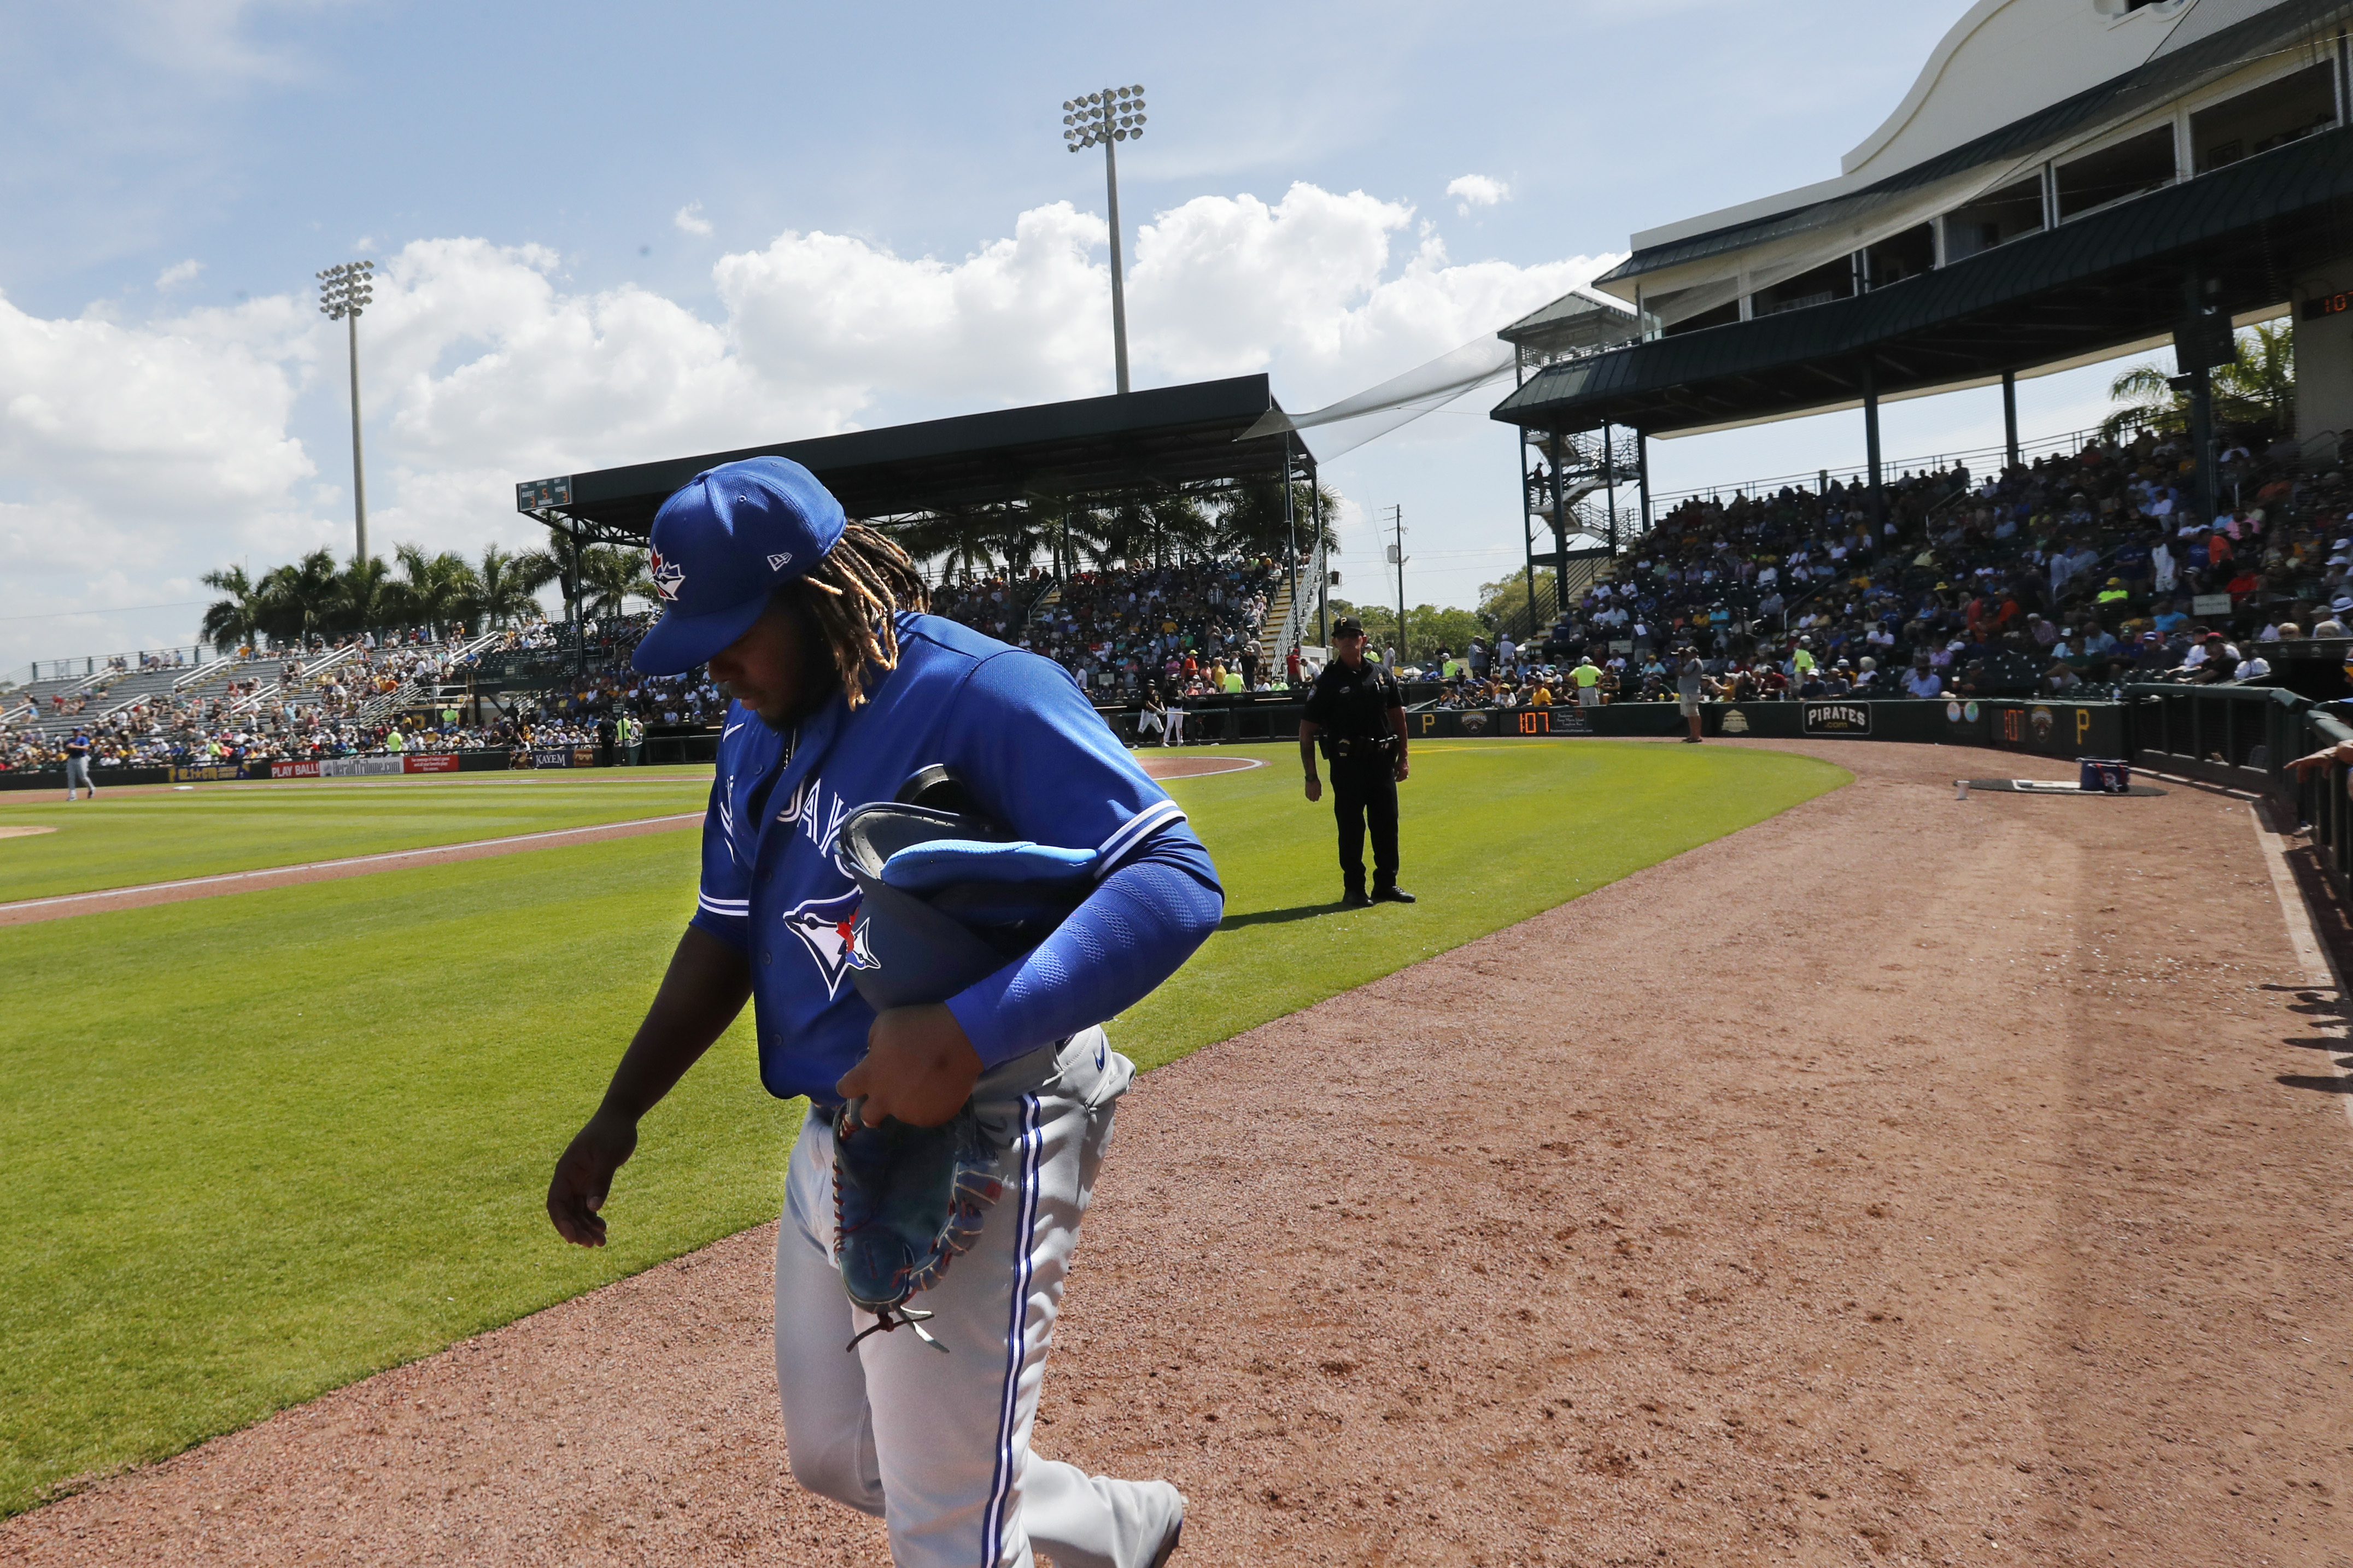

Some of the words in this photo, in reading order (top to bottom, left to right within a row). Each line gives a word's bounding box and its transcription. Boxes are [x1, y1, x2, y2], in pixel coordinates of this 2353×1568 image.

[542, 488, 549, 499] 5
[563, 491, 569, 503] 3
[530, 496, 536, 507] 3
[1341, 616, 1348, 626] P
[1808, 706, 1865, 726] PIRATES
[1421, 713, 1435, 734] P
[2076, 709, 2089, 744] P
[536, 754, 566, 766] KAYEM
[272, 765, 292, 777] PLAY
[295, 763, 319, 775] BALL!
[333, 759, 400, 775] HeraldTribune.com
